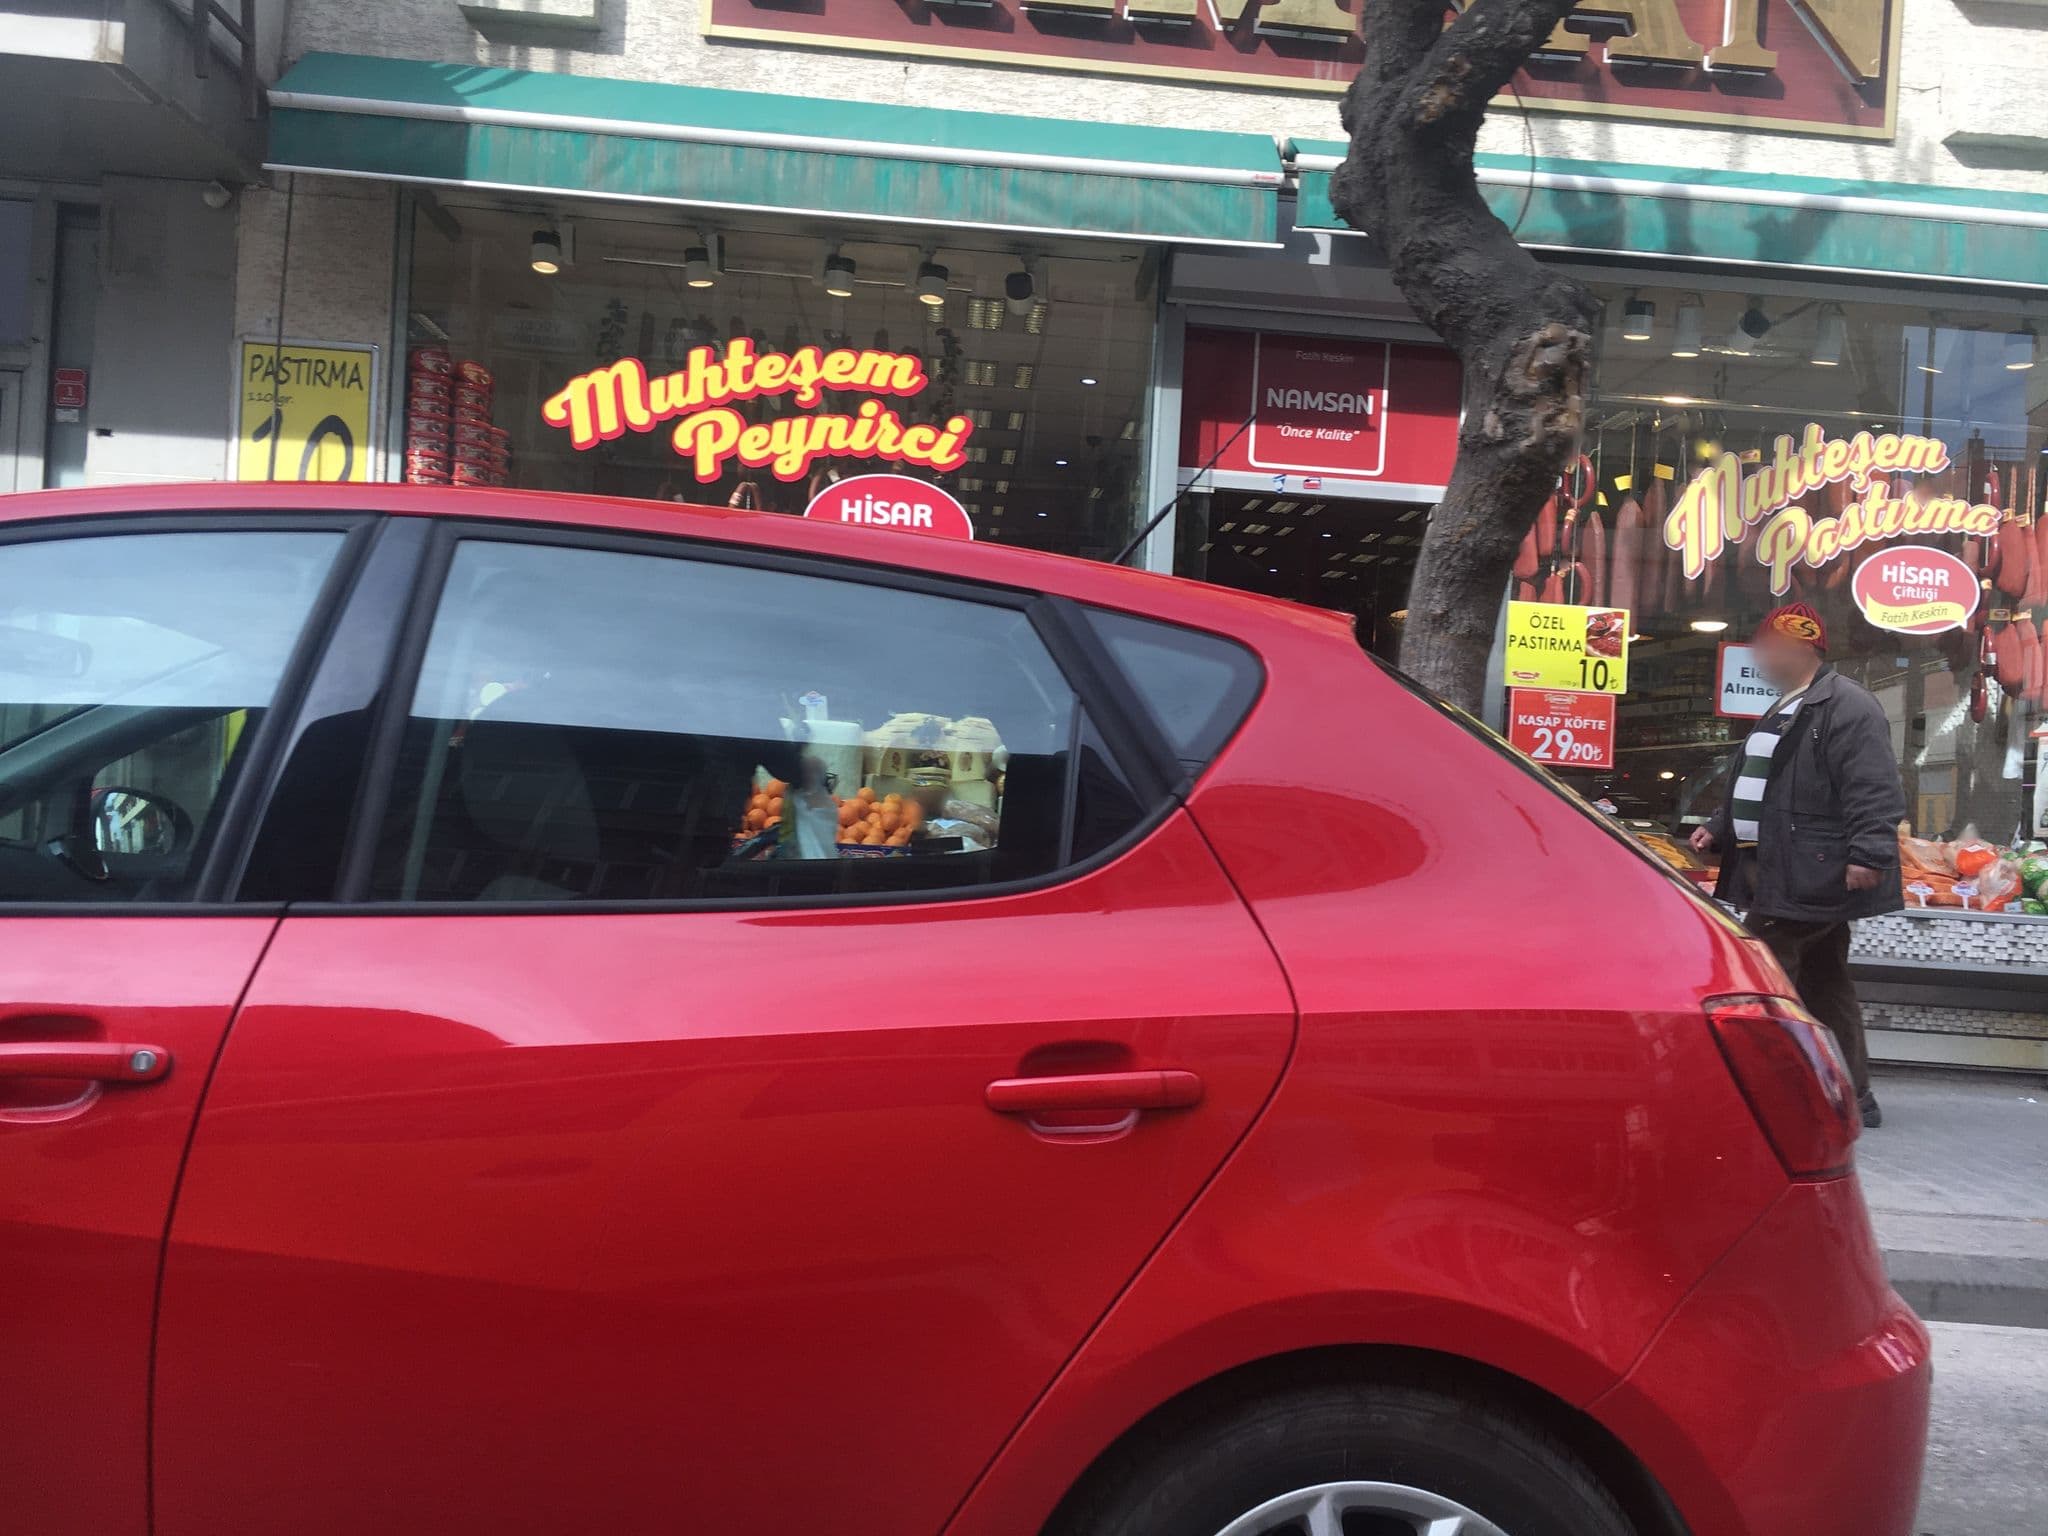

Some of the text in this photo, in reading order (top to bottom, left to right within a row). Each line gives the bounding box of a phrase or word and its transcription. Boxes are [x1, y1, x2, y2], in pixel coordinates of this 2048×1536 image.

[249, 353, 364, 391] PASTIRMA
[542, 337, 927, 450] Muhteşem
[1266, 388, 1375, 415] NAMSAN
[673, 399, 973, 483] Peynirci
[841, 494, 933, 528] HİSAR
[1664, 422, 1950, 580] Muhteşem
[1756, 481, 2001, 596] Pastırma
[1882, 561, 1949, 587] HİSAR
[1893, 586, 1938, 602] Çiftliği
[1530, 612, 1566, 630] ÖZEL
[1881, 606, 1949, 624] Fatih Keskin
[1508, 634, 1583, 653] PASTIRMA
[1518, 714, 1607, 731] KASAP KÖFTE
